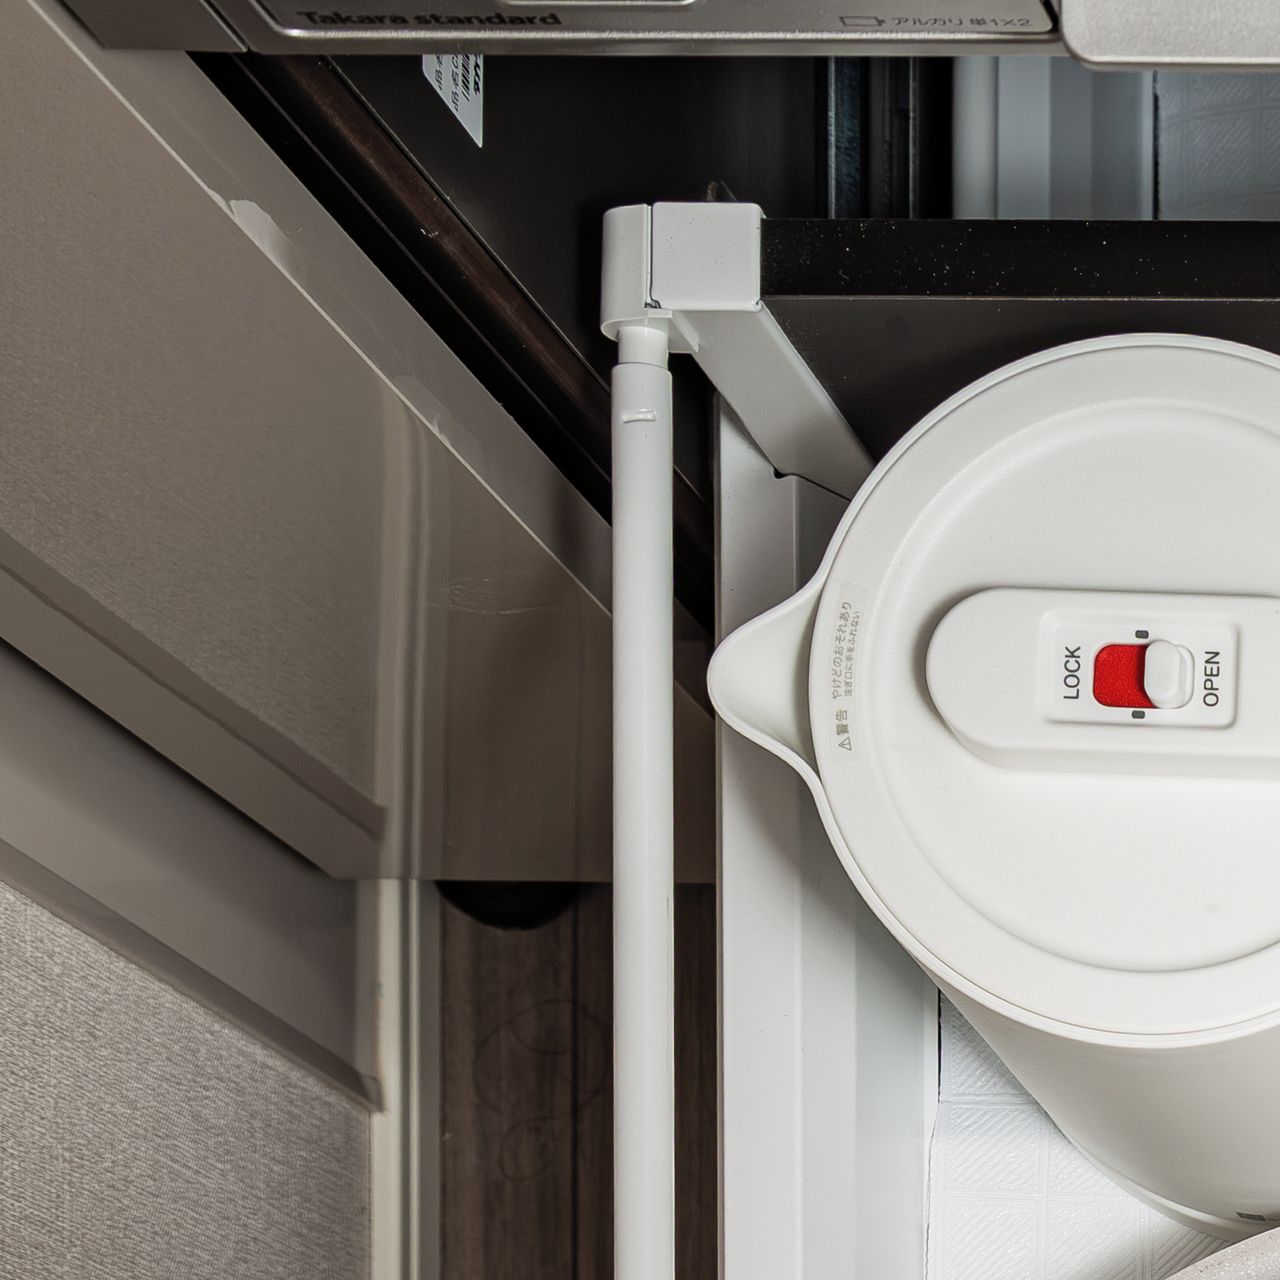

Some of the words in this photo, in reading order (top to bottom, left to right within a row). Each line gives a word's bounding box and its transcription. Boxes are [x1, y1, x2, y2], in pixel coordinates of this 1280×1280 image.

[297, 11, 408, 26] Takara
[414, 13, 561, 26] standard
[832, 602, 852, 699] やけどのおそれあり
[1063, 645, 1081, 699] LOCK
[1203, 651, 1220, 706] OPEN
